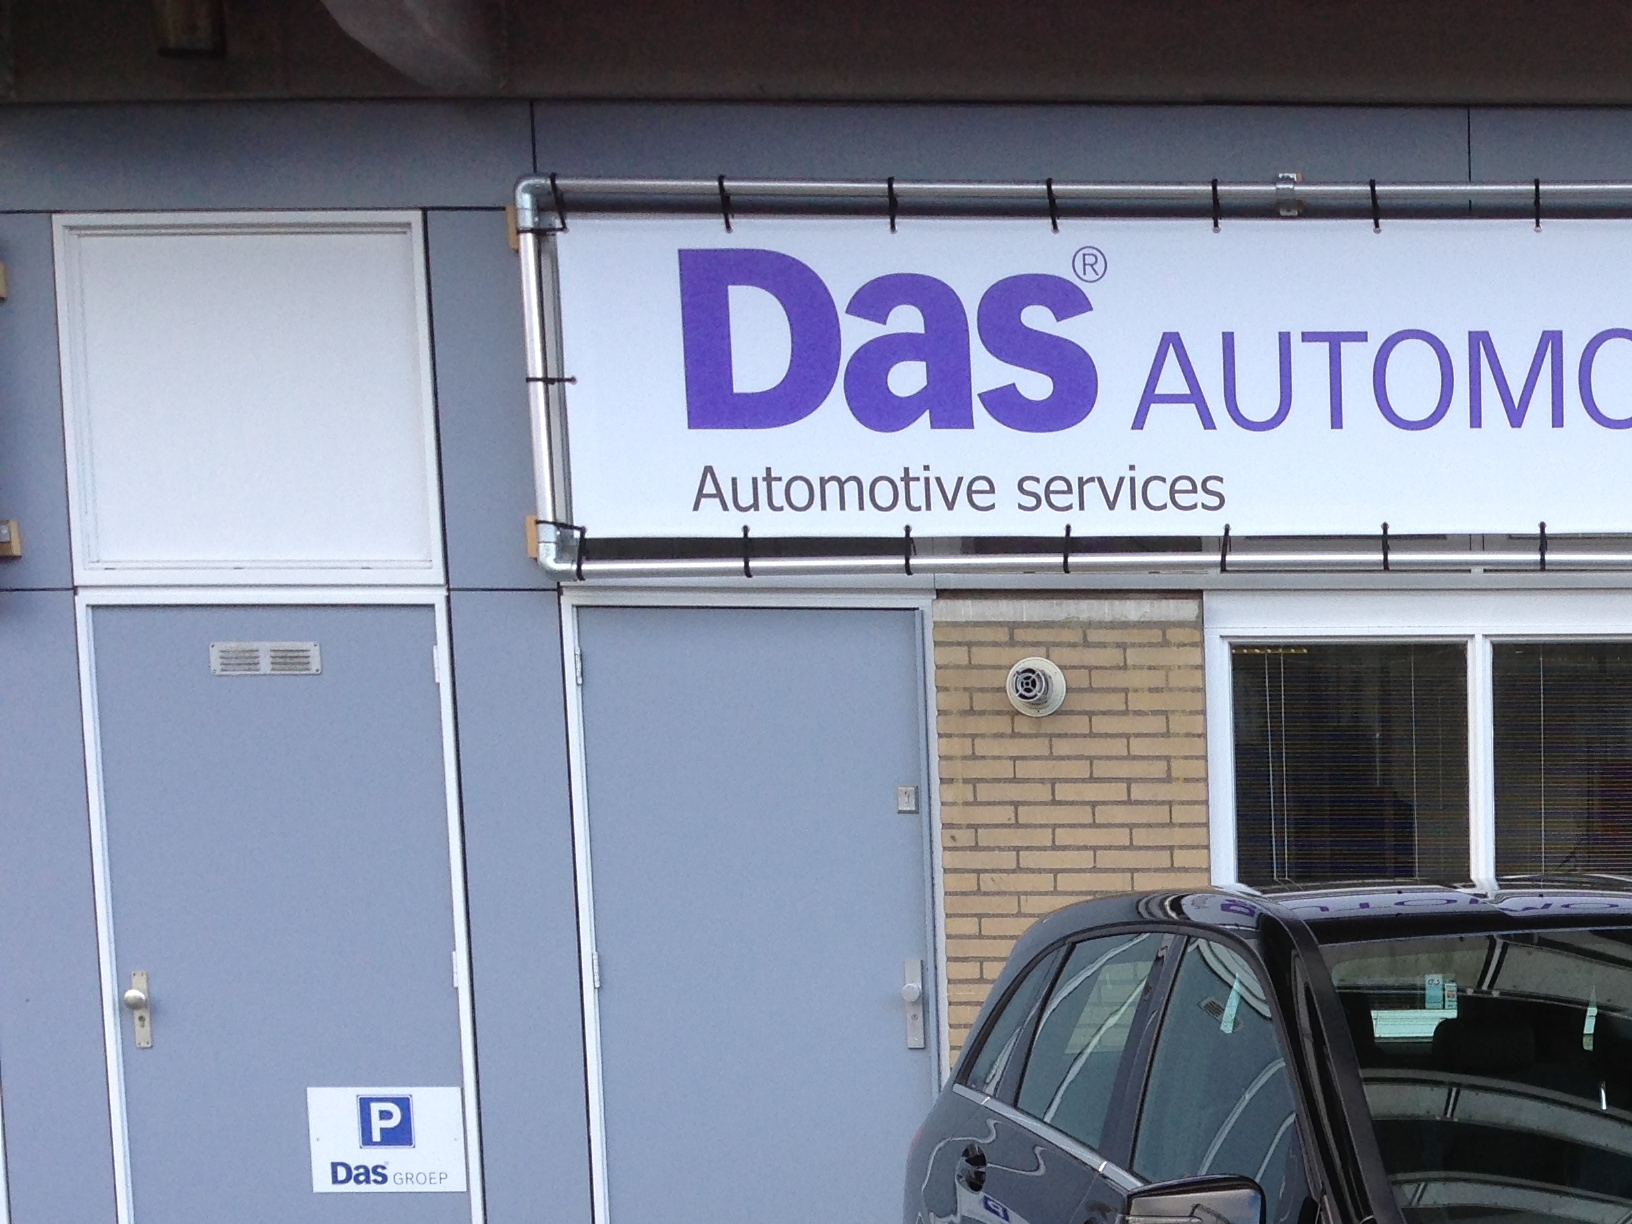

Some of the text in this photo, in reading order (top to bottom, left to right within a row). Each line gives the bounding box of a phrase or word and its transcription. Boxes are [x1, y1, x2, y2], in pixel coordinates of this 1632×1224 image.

[692, 464, 1226, 513] Automotive services
[369, 1101, 402, 1142] P
[330, 1161, 448, 1186] Das GROEP
